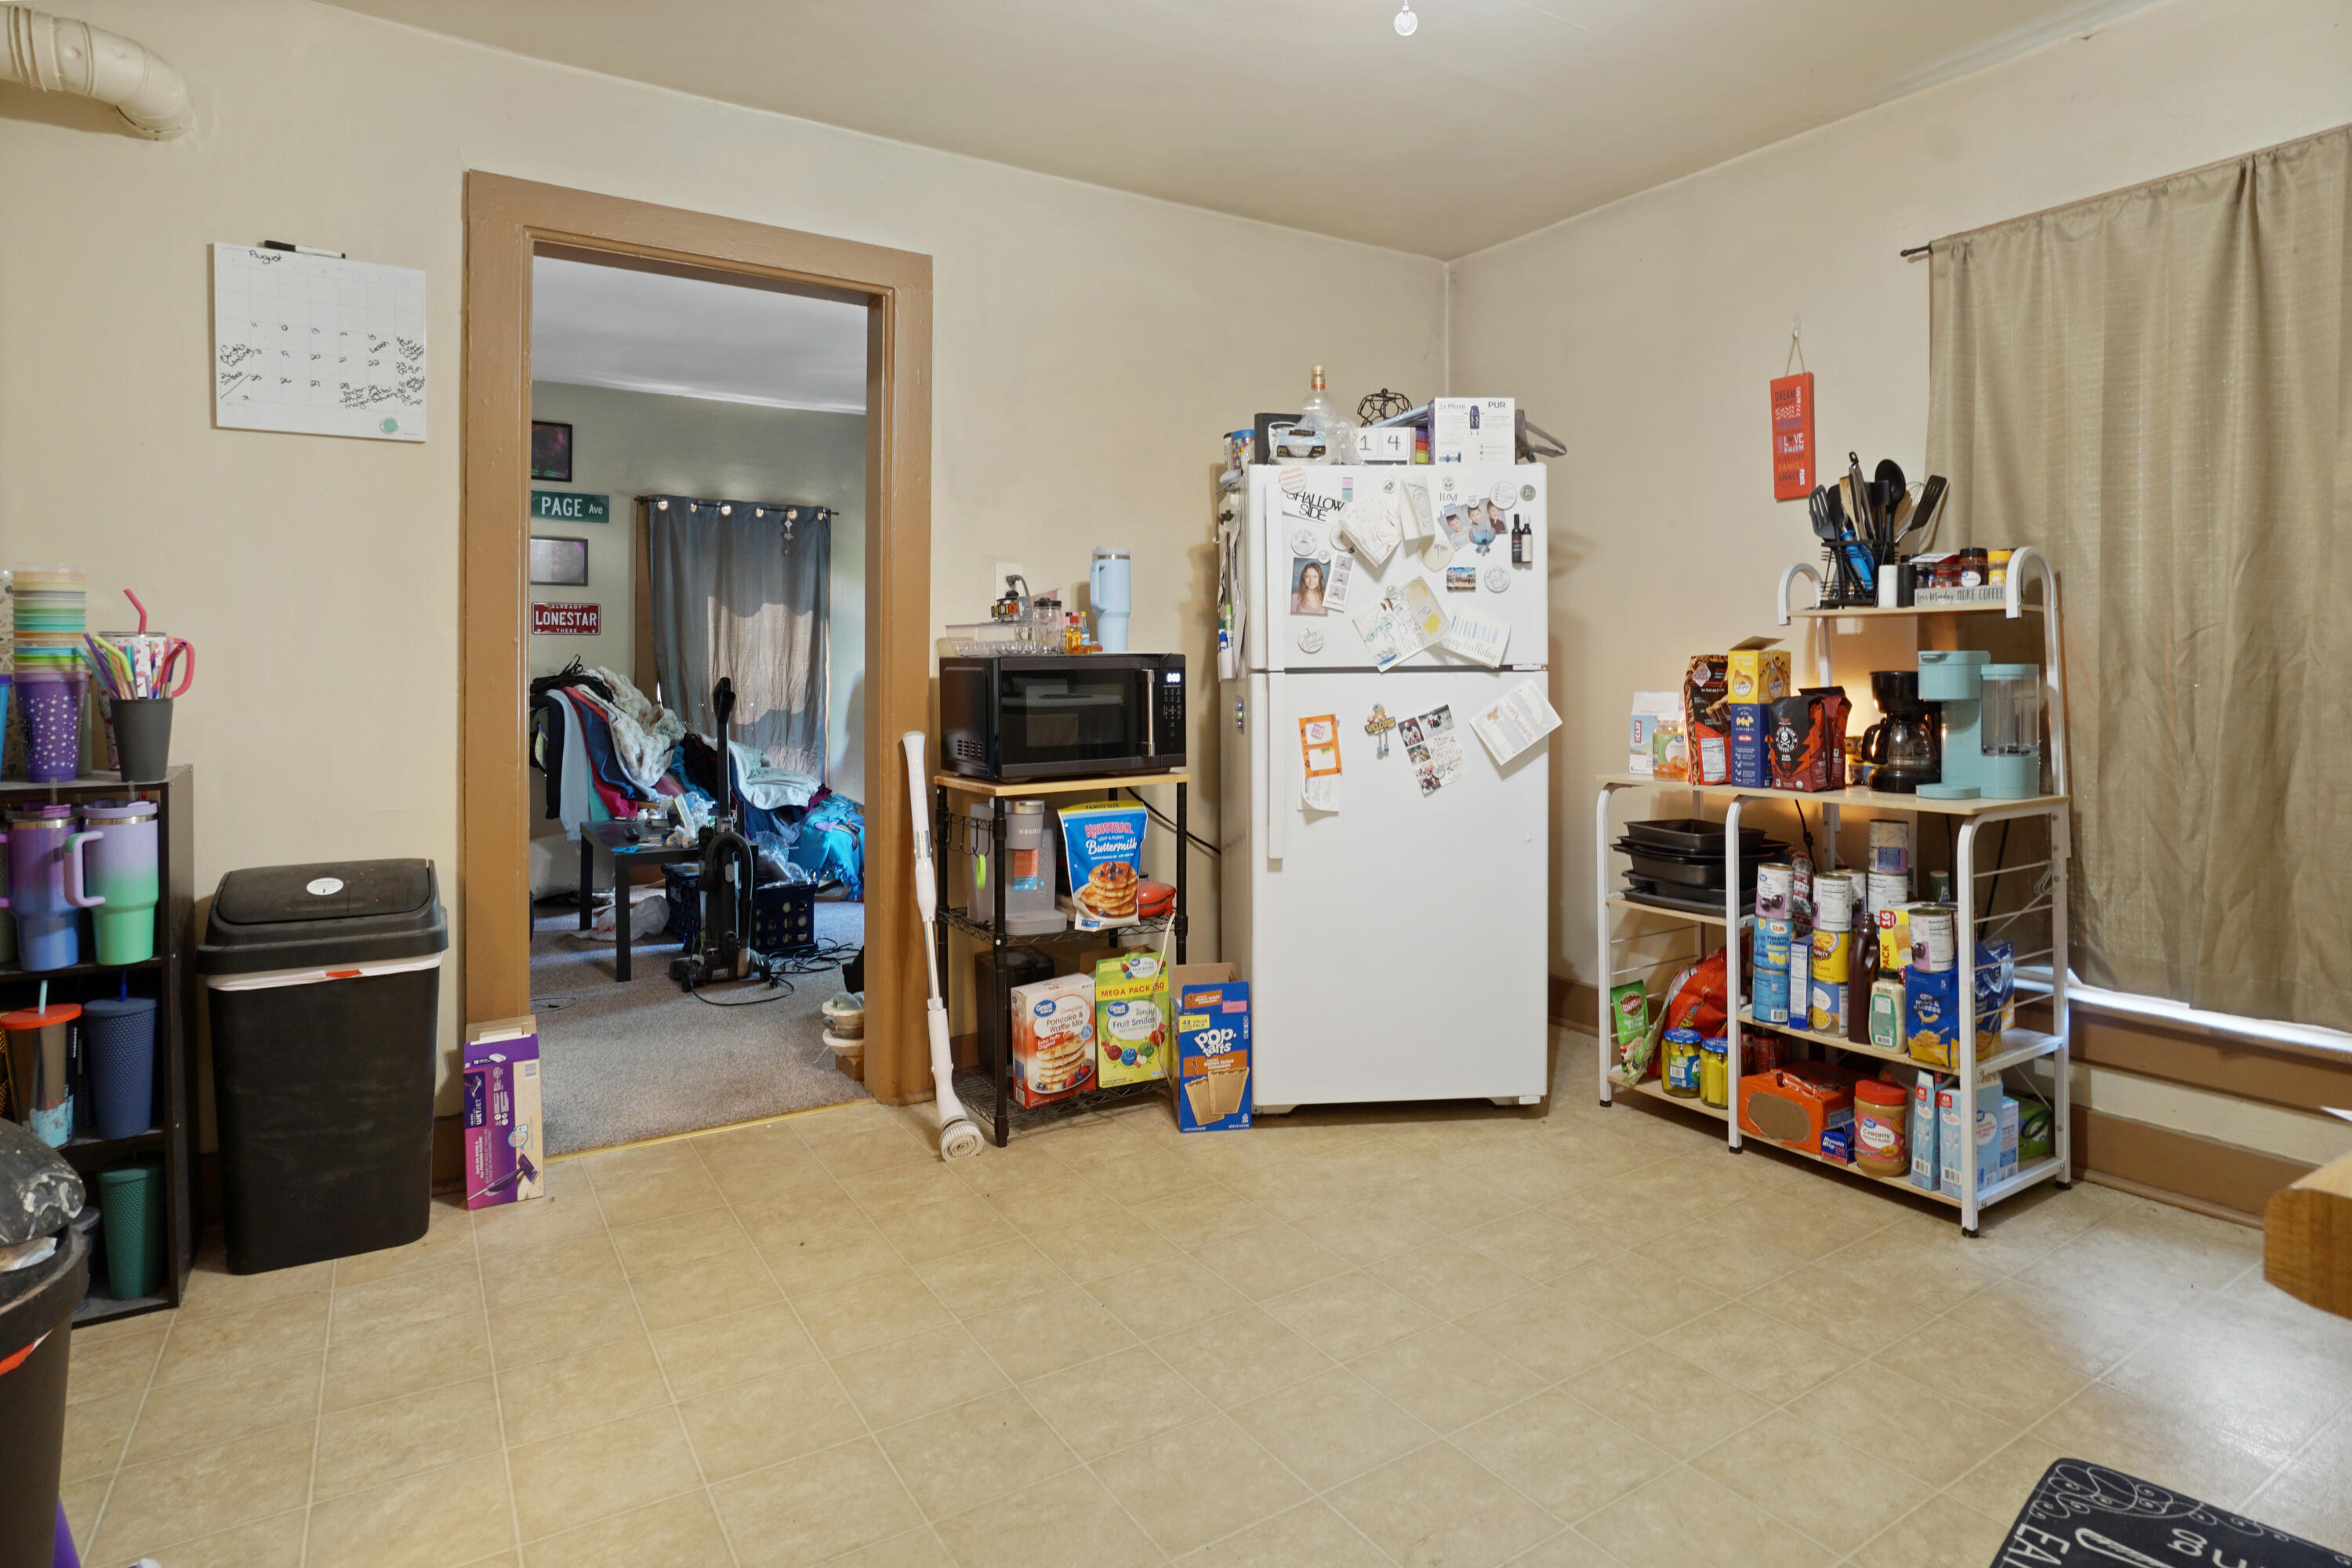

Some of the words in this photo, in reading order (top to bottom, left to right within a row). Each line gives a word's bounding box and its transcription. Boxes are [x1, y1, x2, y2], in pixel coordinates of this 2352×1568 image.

[249, 250, 282, 264] August
[1359, 435, 1371, 451] 1
[1387, 435, 1401, 451] 4
[541, 496, 583, 517] PAGE
[589, 503, 603, 514] Ave
[1286, 492, 1345, 512] SHALLOW
[1298, 503, 1329, 522] SIDE
[1929, 590, 1955, 604] Monday
[1957, 589, 1974, 601] MORE
[1979, 587, 2003, 600] COFFEE
[535, 611, 597, 626] LONESTAR
[1366, 717, 1396, 733] WELCOME
[1085, 822, 1134, 839] KRUSTEAZ
[1085, 837, 1138, 855] Buttermilk
[1882, 912, 1891, 927] 16
[1101, 989, 1126, 997] MEGA
[1129, 985, 1150, 994] PACK
[1036, 1002, 1052, 1011] Great
[1136, 1008, 1156, 1017] Tangy
[1047, 1013, 1077, 1026] Pancake
[1112, 1019, 1130, 1029] Fruit
[1049, 1022, 1070, 1033] Waffle
[1202, 1042, 1232, 1058] tarts
[1824, 1136, 1845, 1147] Reynolds
[1863, 1129, 1890, 1140] Creamy
